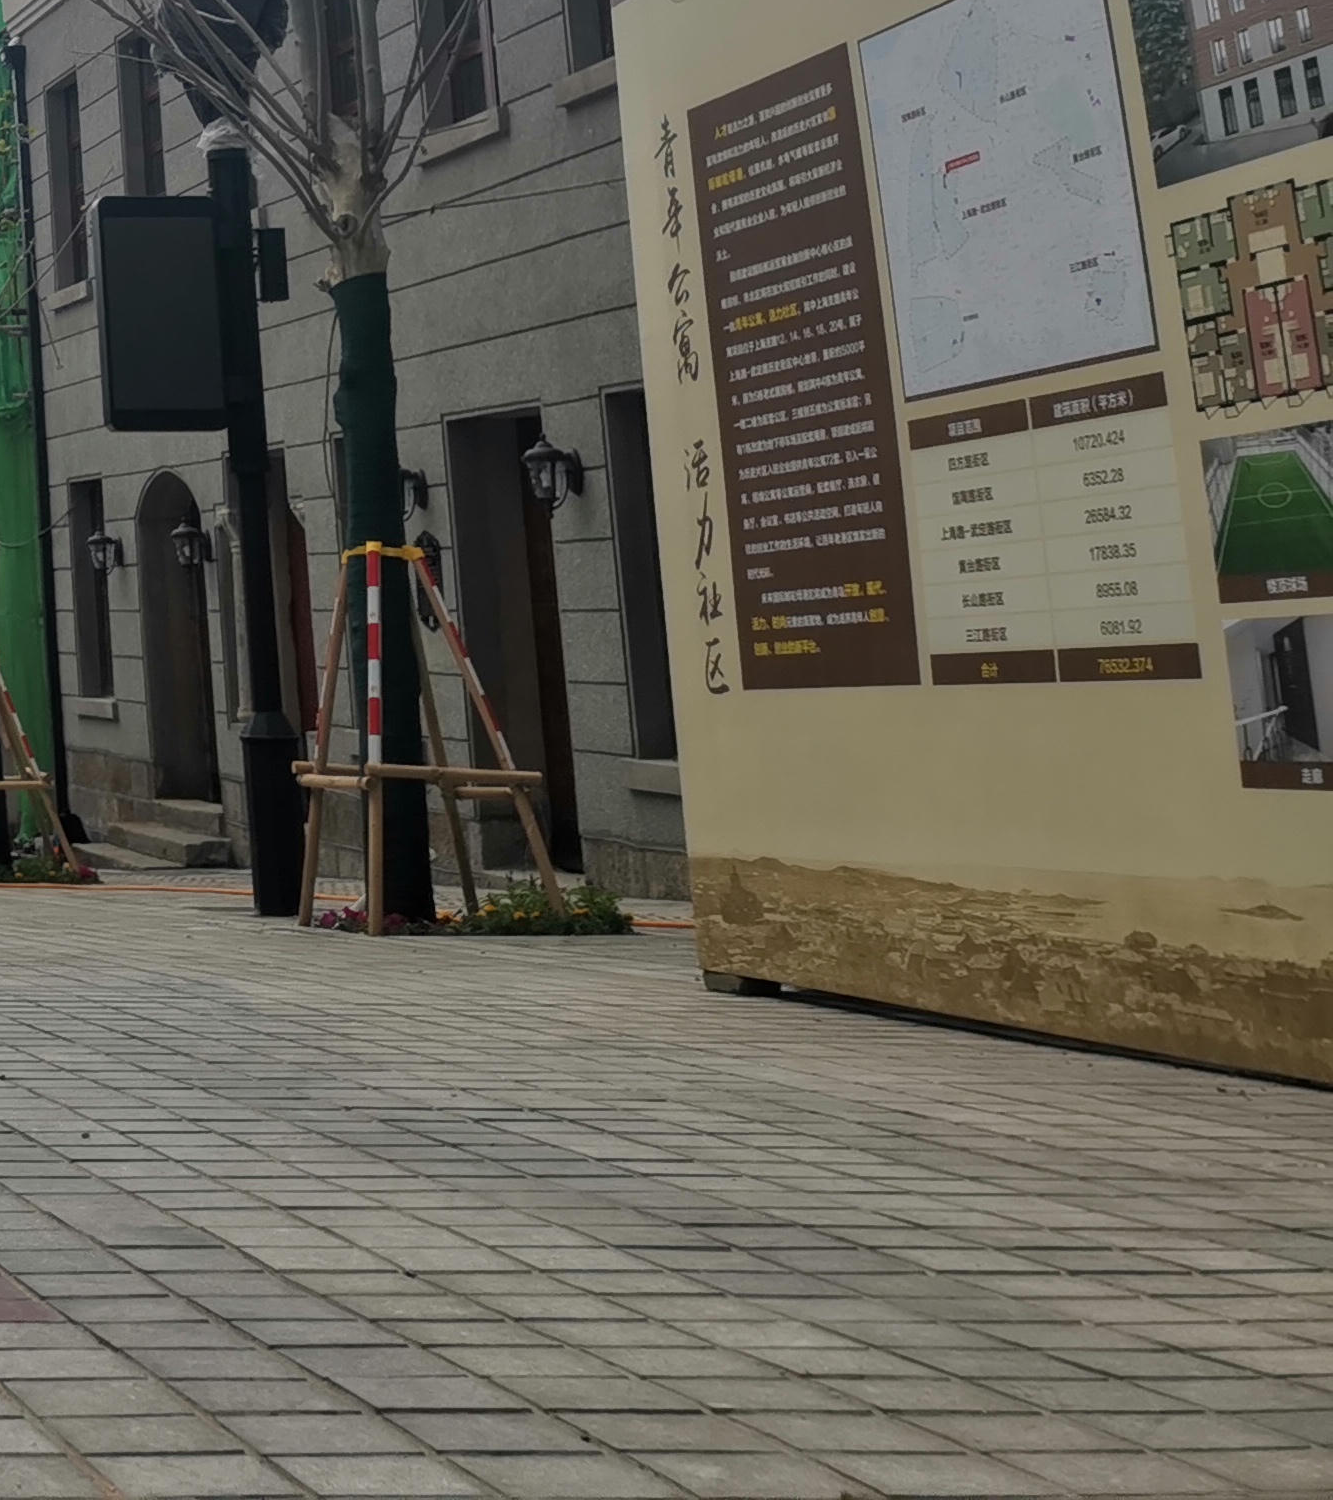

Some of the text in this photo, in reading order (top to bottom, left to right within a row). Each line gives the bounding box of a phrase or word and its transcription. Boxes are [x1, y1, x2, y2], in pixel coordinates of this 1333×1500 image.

[1071, 428, 1126, 452] 10720.424
[1081, 466, 1125, 488] 6352.28
[1083, 503, 1132, 525] 26584.32
[1088, 541, 1137, 562] 17838.35
[683, 439, 731, 695] 活力社区
[1094, 579, 1139, 599] 8955.08
[1098, 618, 1143, 637] 6081.92
